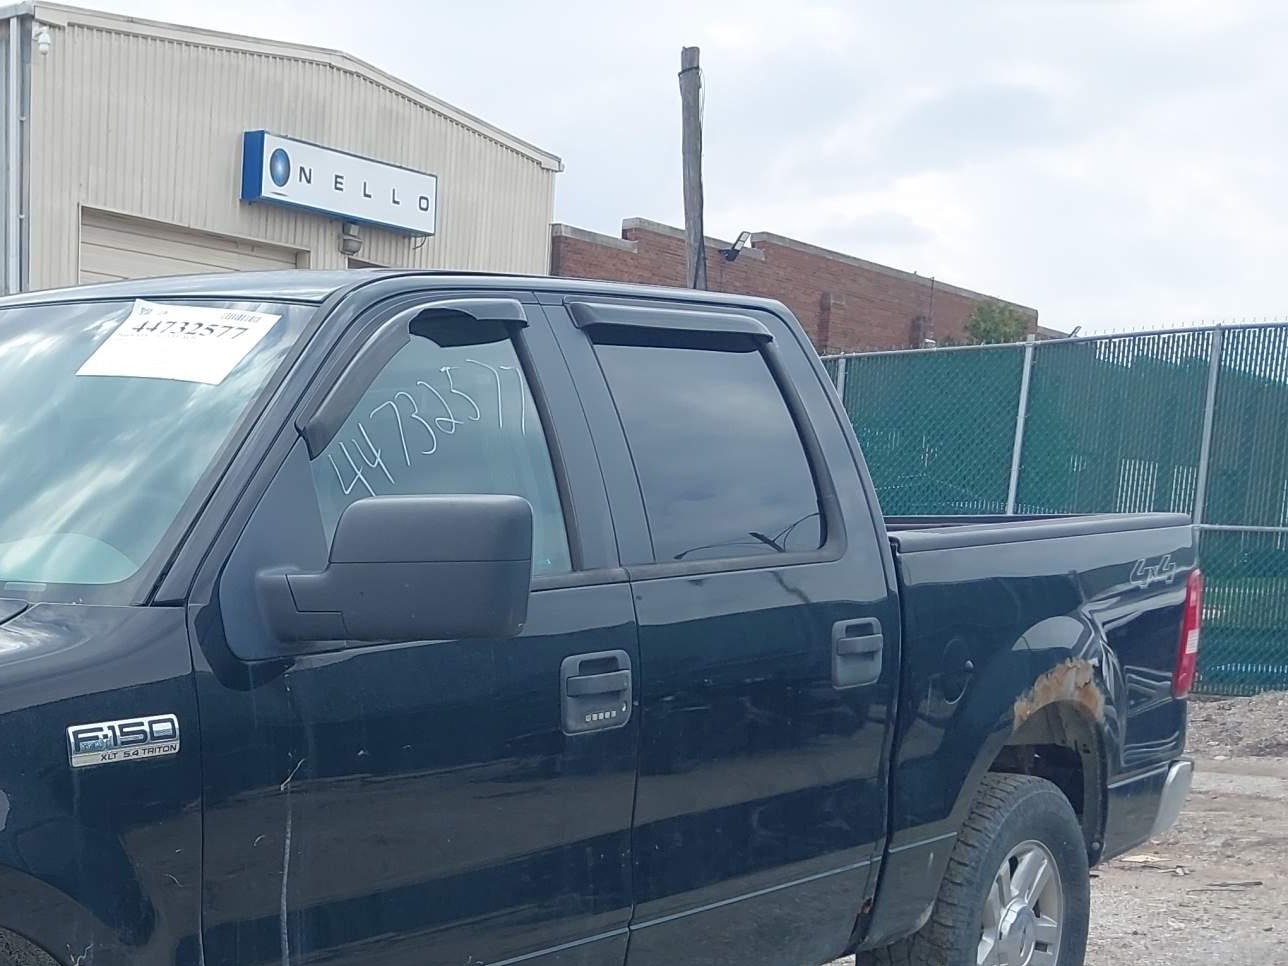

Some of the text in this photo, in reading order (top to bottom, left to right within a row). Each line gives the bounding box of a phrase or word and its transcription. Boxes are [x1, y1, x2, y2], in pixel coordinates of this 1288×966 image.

[131, 320, 248, 339] 44732577
[328, 359, 526, 496] 44732577
[1129, 554, 1177, 590] 4x4
[72, 718, 178, 753] F-150
[100, 752, 118, 761] XLT
[141, 744, 177, 755] TRITON
